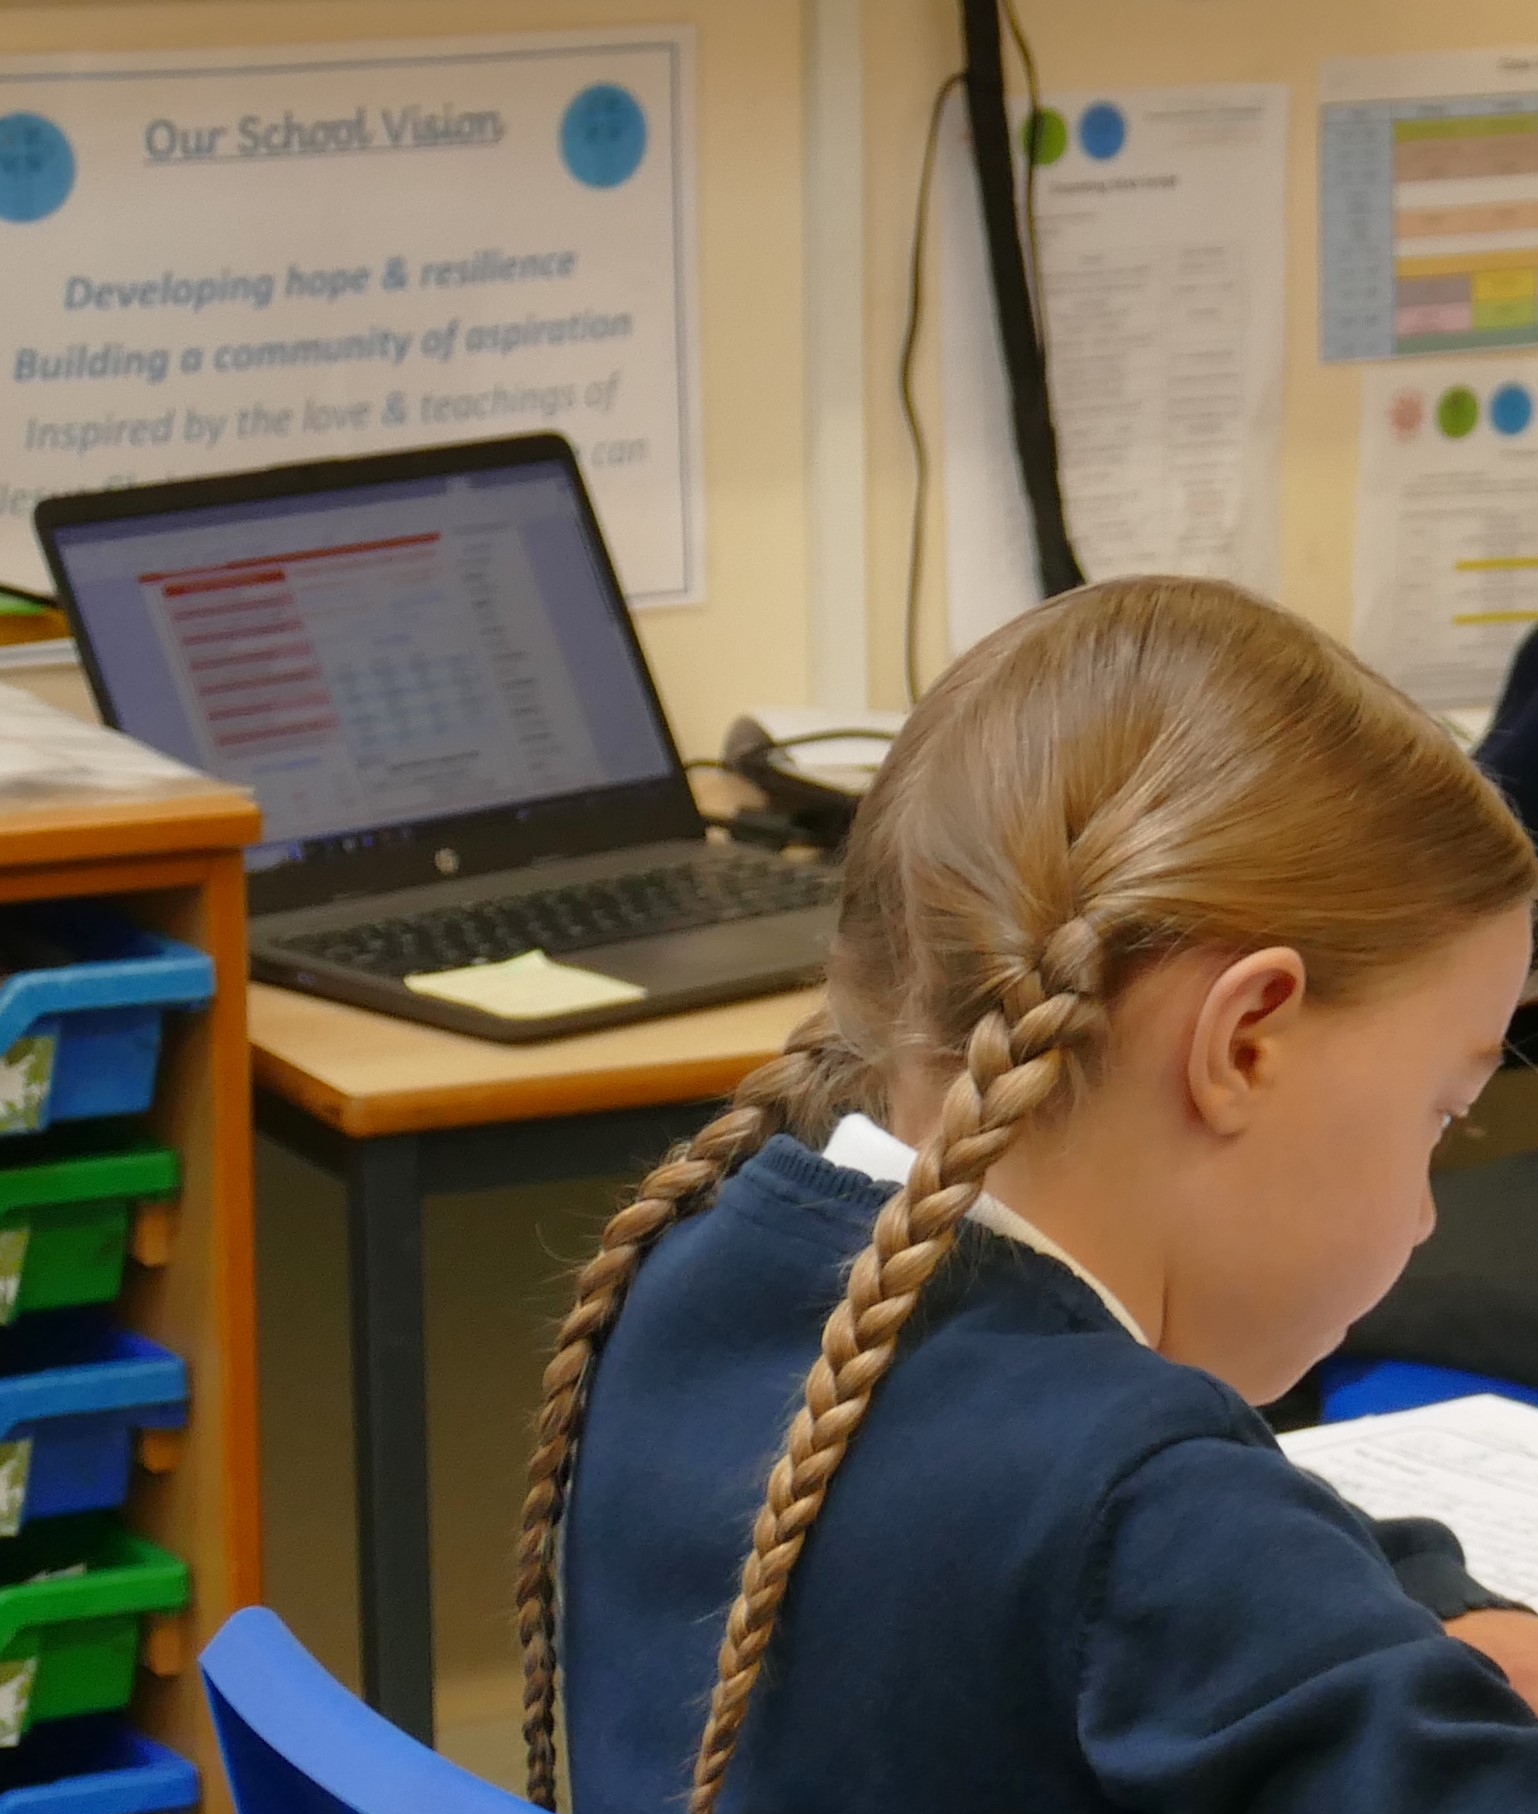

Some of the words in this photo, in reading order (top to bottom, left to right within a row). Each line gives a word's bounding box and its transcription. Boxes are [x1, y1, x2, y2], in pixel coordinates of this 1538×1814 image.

[144, 118, 226, 160] Our
[236, 109, 375, 157] School
[381, 102, 505, 147] Vision
[63, 268, 275, 313] Developing
[284, 259, 370, 302] hope
[381, 257, 408, 291] &
[420, 247, 578, 289] resilience
[12, 341, 170, 387] Building
[180, 349, 202, 375] a
[212, 324, 410, 374] community
[420, 319, 461, 362] of
[465, 309, 634, 358] aspiration
[24, 413, 176, 456] Inspired
[182, 407, 229, 452] by
[237, 402, 294, 441] the
[302, 396, 370, 434] love
[381, 393, 408, 427] &
[420, 373, 576, 425] teachings
[584, 370, 623, 411] of
[592, 436, 650, 468] can
